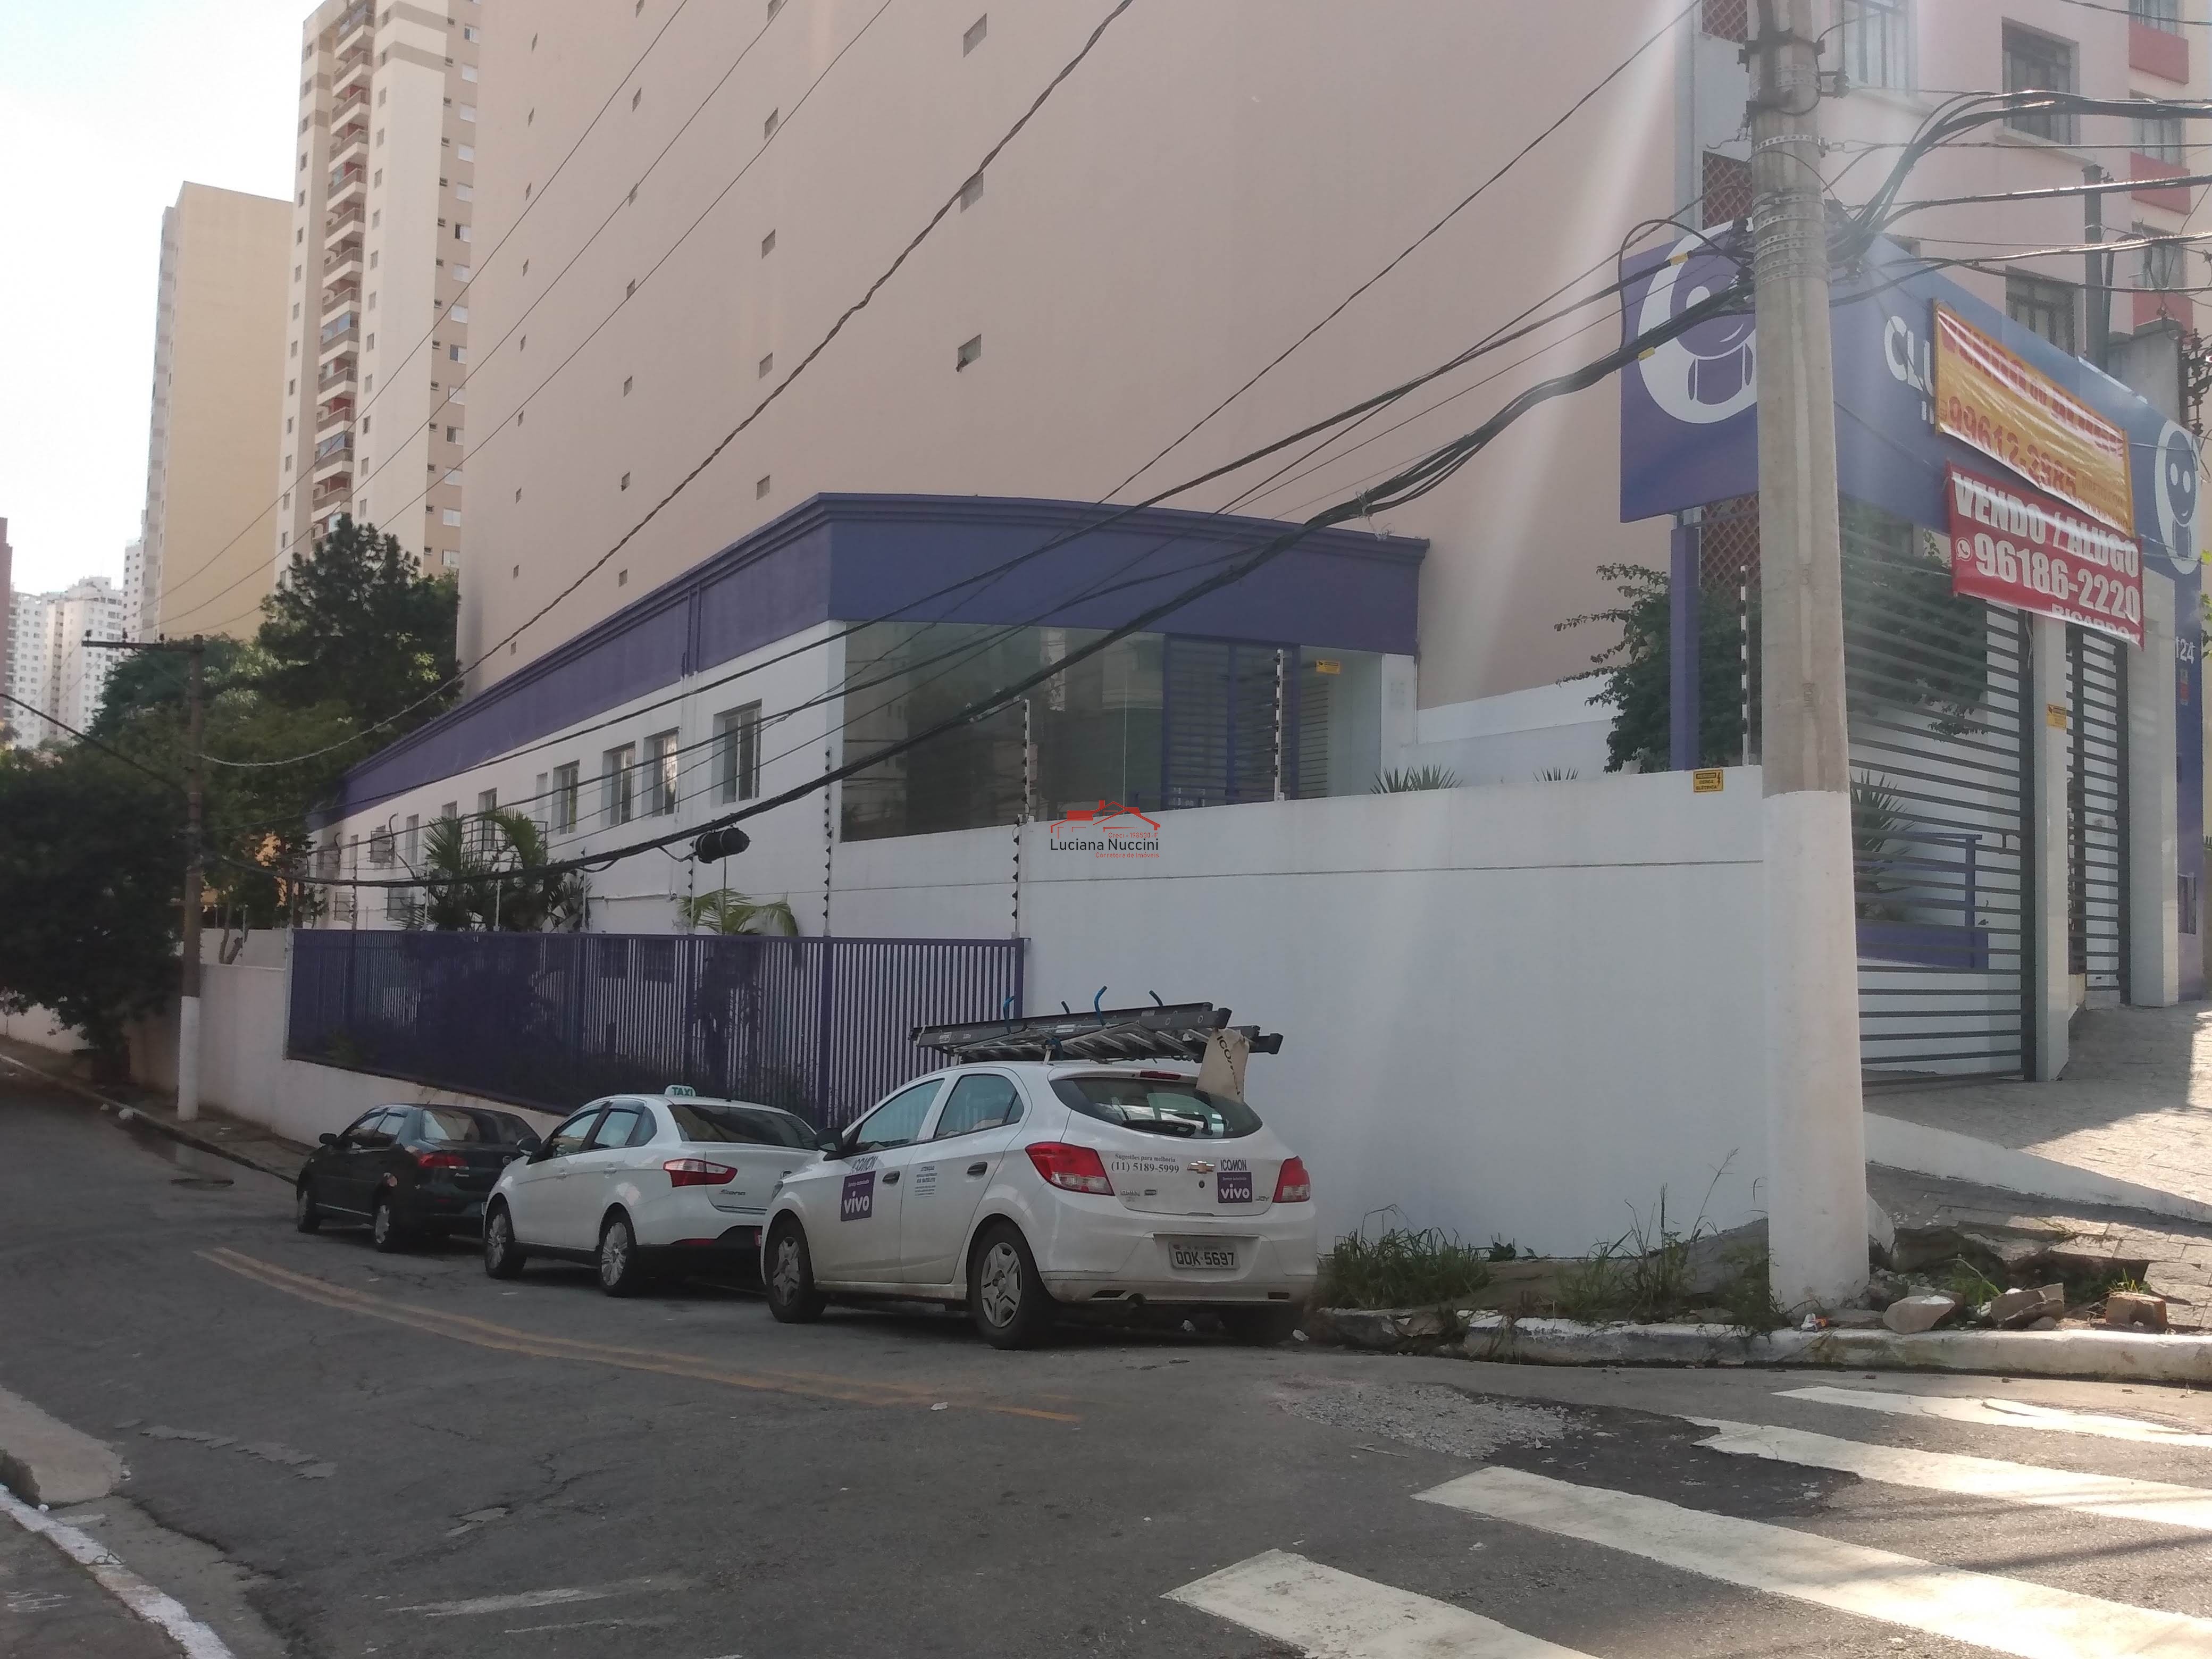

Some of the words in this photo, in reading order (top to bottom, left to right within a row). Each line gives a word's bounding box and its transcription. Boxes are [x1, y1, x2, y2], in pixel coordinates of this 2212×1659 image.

[1953, 471, 2046, 544] VENDO
[2066, 517, 2139, 577] ALUGO
[1974, 533, 2141, 626] 96186-2220
[2176, 636, 2194, 664] 124
[672, 1086, 693, 1096] TAXI
[1111, 1161, 1130, 1172] (11)
[1133, 1162, 1179, 1174] 5189-5999
[1220, 1159, 1247, 1171] ICOMON
[1220, 1183, 1250, 1199] vivo
[844, 1191, 870, 1214] vivo
